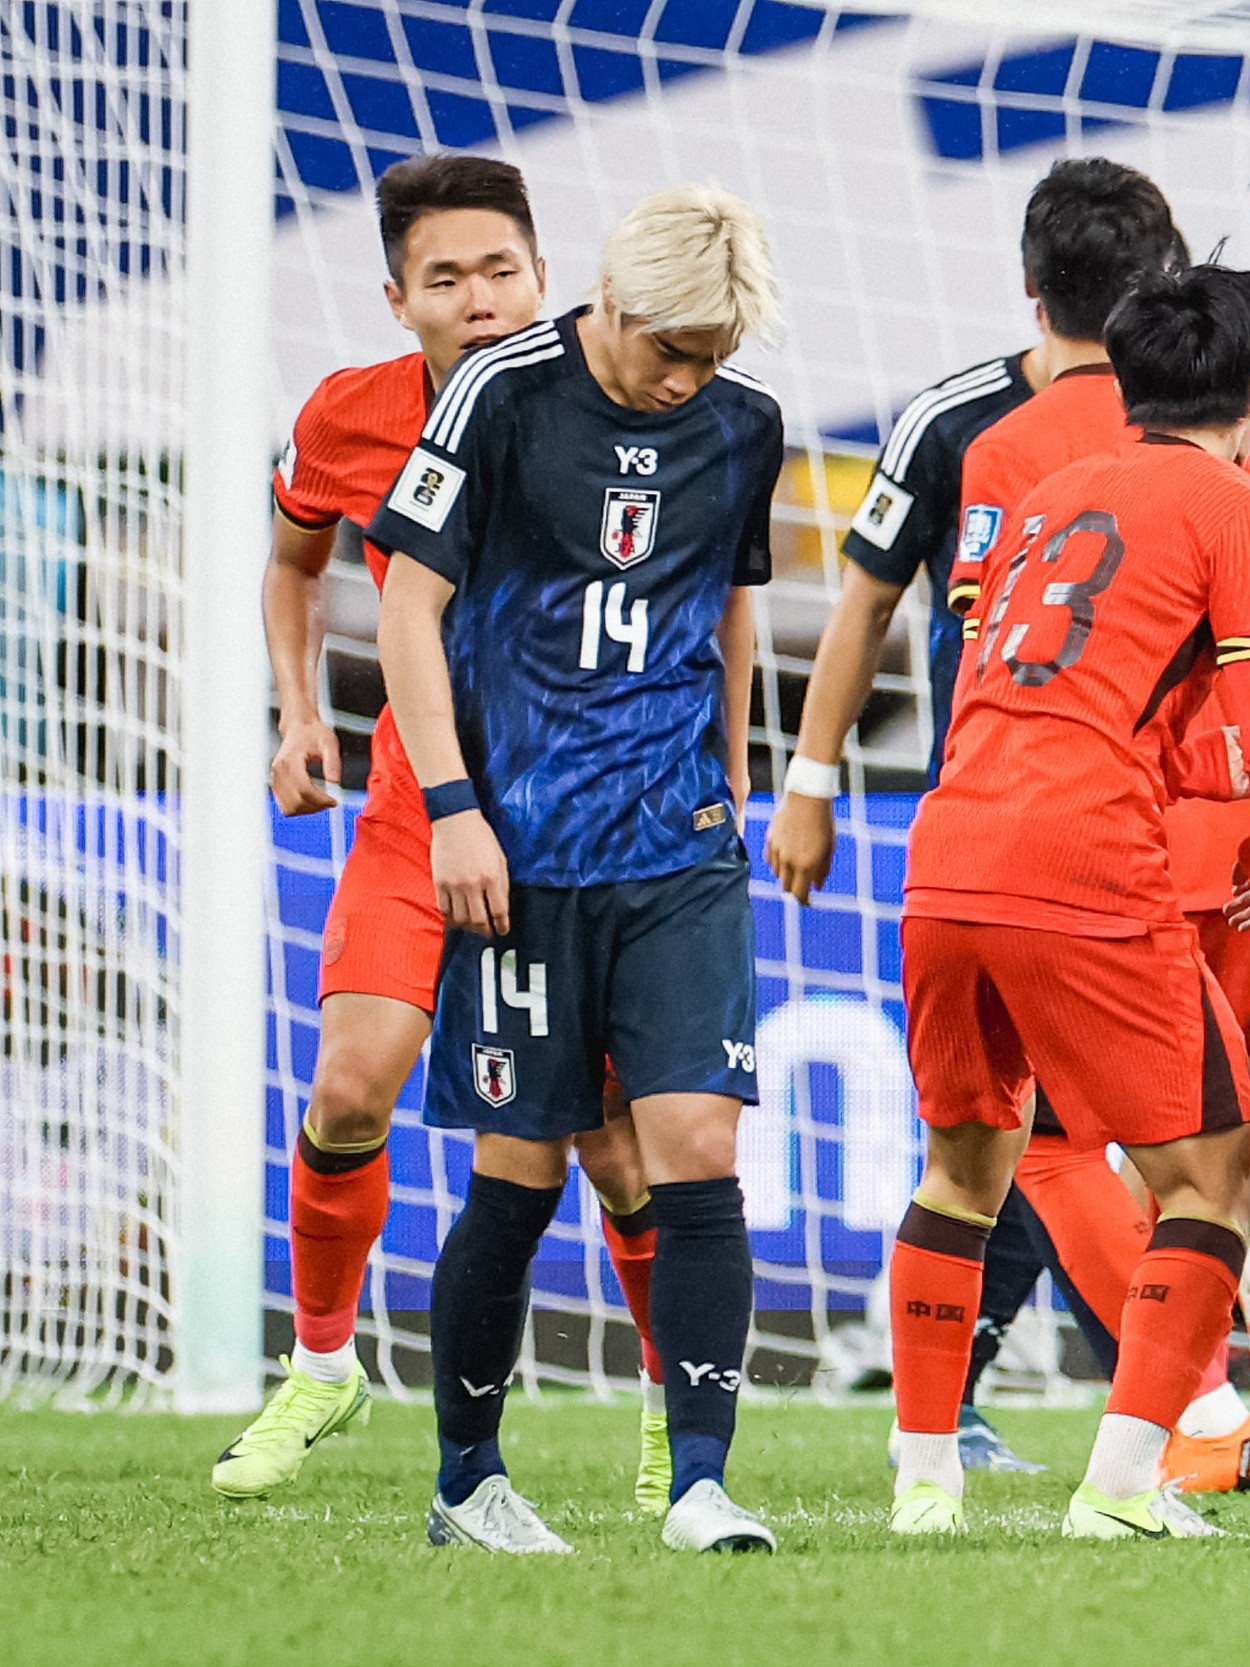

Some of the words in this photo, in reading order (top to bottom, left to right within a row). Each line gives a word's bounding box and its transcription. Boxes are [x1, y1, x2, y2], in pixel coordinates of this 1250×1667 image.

[579, 580, 649, 672] 14
[974, 509, 1126, 689] 13
[480, 947, 549, 1037] 14
[721, 1039, 756, 1073] Y-3
[906, 1299, 965, 1323] 中国
[679, 1360, 741, 1392] Y-3
